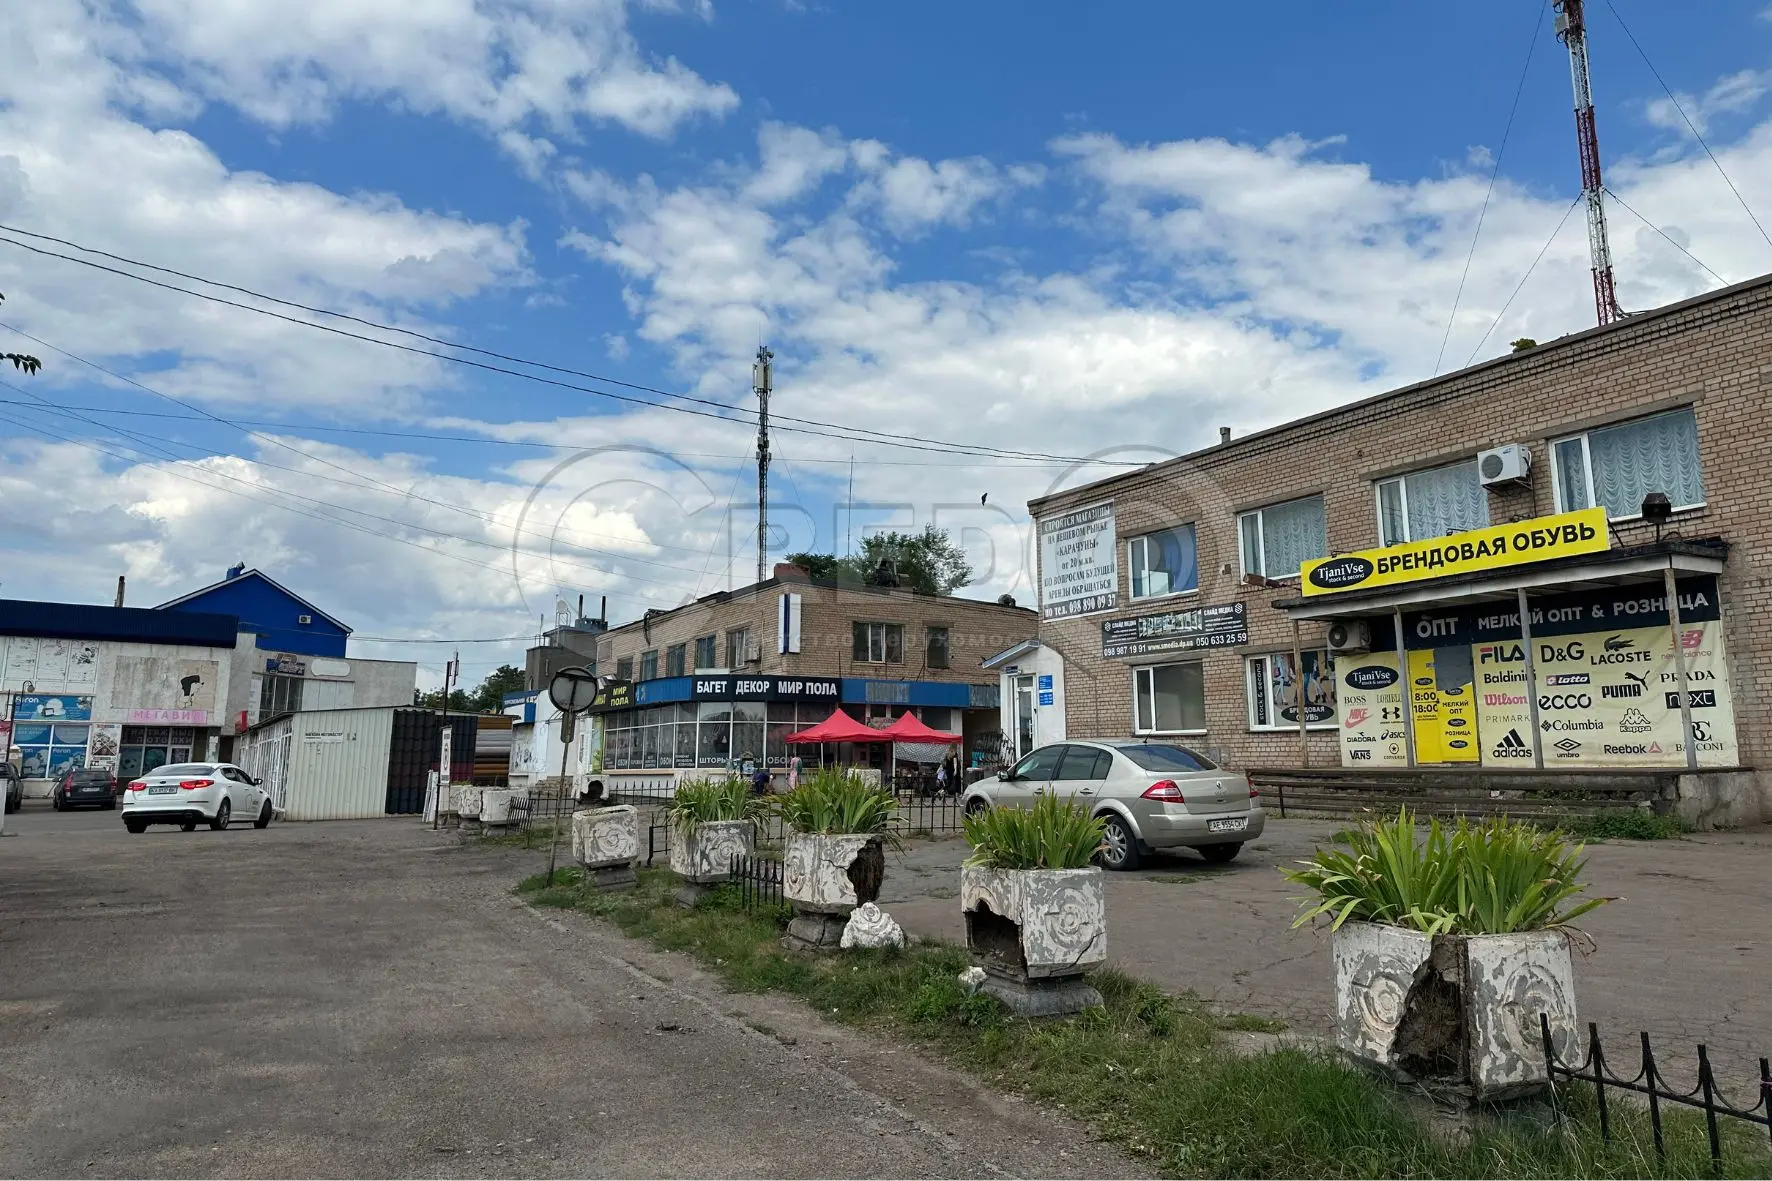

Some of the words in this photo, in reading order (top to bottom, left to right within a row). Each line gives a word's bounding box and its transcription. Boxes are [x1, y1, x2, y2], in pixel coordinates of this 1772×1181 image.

[1075, 505, 1110, 525] МАГАЗИНЫ
[1086, 521, 1108, 535] РЫНКЕ
[1377, 536, 1507, 575] БРЕНДОВАЯ
[1512, 522, 1596, 552] ОБУВЬ
[1070, 557, 1078, 568] 20
[1053, 571, 1085, 586] ВОПРОСАМ
[1086, 563, 1115, 579] БУДУЩЕЙ
[1317, 562, 1365, 582] TjaniVse
[1328, 575, 1342, 584] stock
[1347, 571, 1365, 581] second
[1048, 588, 1071, 600] АРЕНДЫ
[1071, 578, 1112, 596] ОБРАЩАТЬСЯ
[1069, 599, 1082, 614] 098
[1082, 597, 1095, 612] 890
[1096, 595, 1105, 609] 09
[1107, 593, 1116, 607] 37
[1547, 606, 1584, 623] ОПТ
[1591, 604, 1605, 618] &
[1416, 616, 1459, 638] ОПТ
[1103, 647, 1115, 657] 098
[1116, 645, 1127, 655] 987
[1129, 645, 1137, 654] 19
[1138, 644, 1146, 652] 91
[1196, 637, 1209, 647] 050
[1211, 635, 1224, 645] 633
[1226, 633, 1236, 644] 25
[1237, 632, 1248, 642] 59
[1480, 644, 1526, 664] FILA
[1540, 641, 1585, 663] D&G
[1590, 650, 1652, 666] LACOSTE
[1683, 650, 1712, 659] alance
[1255, 663, 1263, 690] second
[1353, 670, 1391, 683] TjaniVse
[1484, 669, 1537, 684] Baldinii
[613, 686, 627, 695] МИР
[696, 680, 727, 693] БАГЕТ
[735, 680, 770, 695] ДЕКОР
[778, 681, 803, 694] МИР
[805, 682, 837, 695] ПОЛА
[1601, 684, 1642, 698] PUMA
[610, 696, 629, 706] ПОЛА
[1344, 695, 1367, 704] BOSS
[1414, 691, 1437, 701] 8:00
[1484, 693, 1529, 706] Wilson
[1538, 693, 1593, 710] ecco
[1442, 699, 1469, 708] МЕЛКИЙ
[1350, 708, 1369, 721] NIKE
[1485, 714, 1530, 723] PRIMARK
[1552, 720, 1605, 732] Columbia
[1620, 725, 1652, 734] Kappa
[1492, 746, 1533, 759] adidas
[1603, 744, 1647, 755] Reebok
[1675, 742, 1725, 753] BCONI
[1349, 749, 1372, 760] VANS
[1556, 751, 1580, 759] umbro
